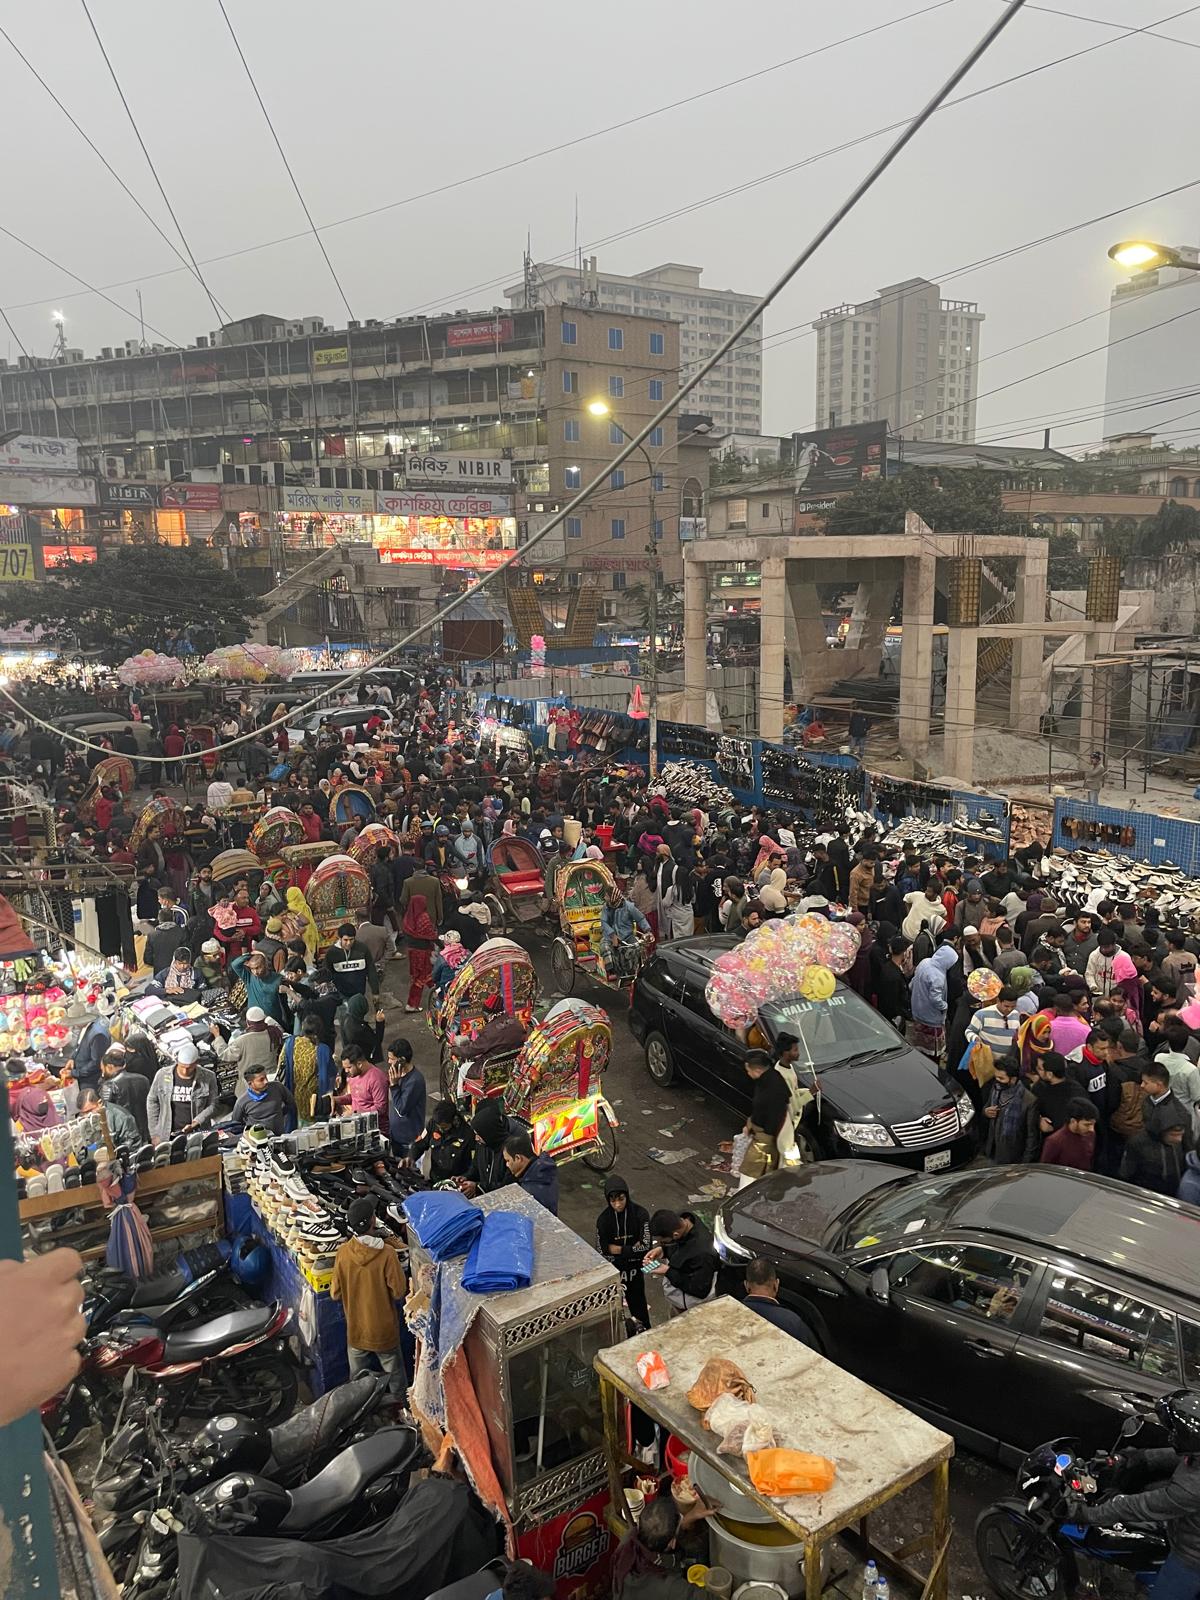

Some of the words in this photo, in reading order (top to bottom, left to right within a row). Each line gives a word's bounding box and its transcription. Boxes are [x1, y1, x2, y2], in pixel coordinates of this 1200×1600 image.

[458, 460, 502, 476] NIBIR
[806, 501, 836, 512] President
[782, 1002, 813, 1016] RALLI
[827, 996, 846, 1006] ART
[556, 1533, 608, 1578] BURGER
